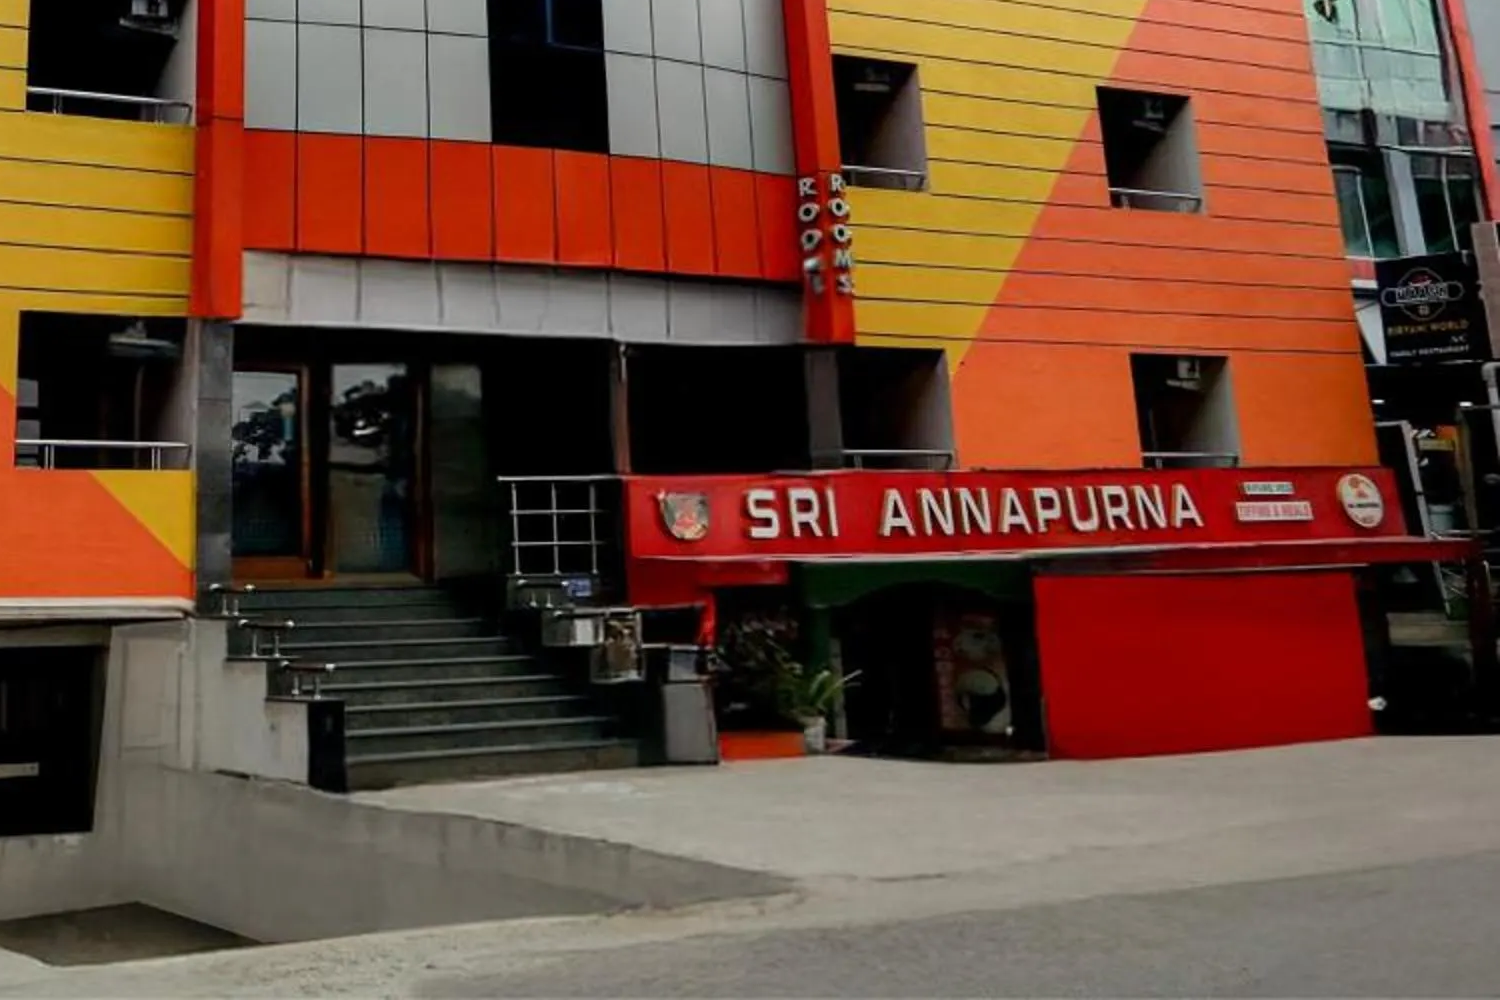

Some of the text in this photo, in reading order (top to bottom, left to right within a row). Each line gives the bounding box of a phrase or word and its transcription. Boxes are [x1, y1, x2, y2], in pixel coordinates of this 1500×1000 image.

[827, 174, 854, 294] ROOMS
[745, 483, 1203, 539] SRI ANNAPURNA
